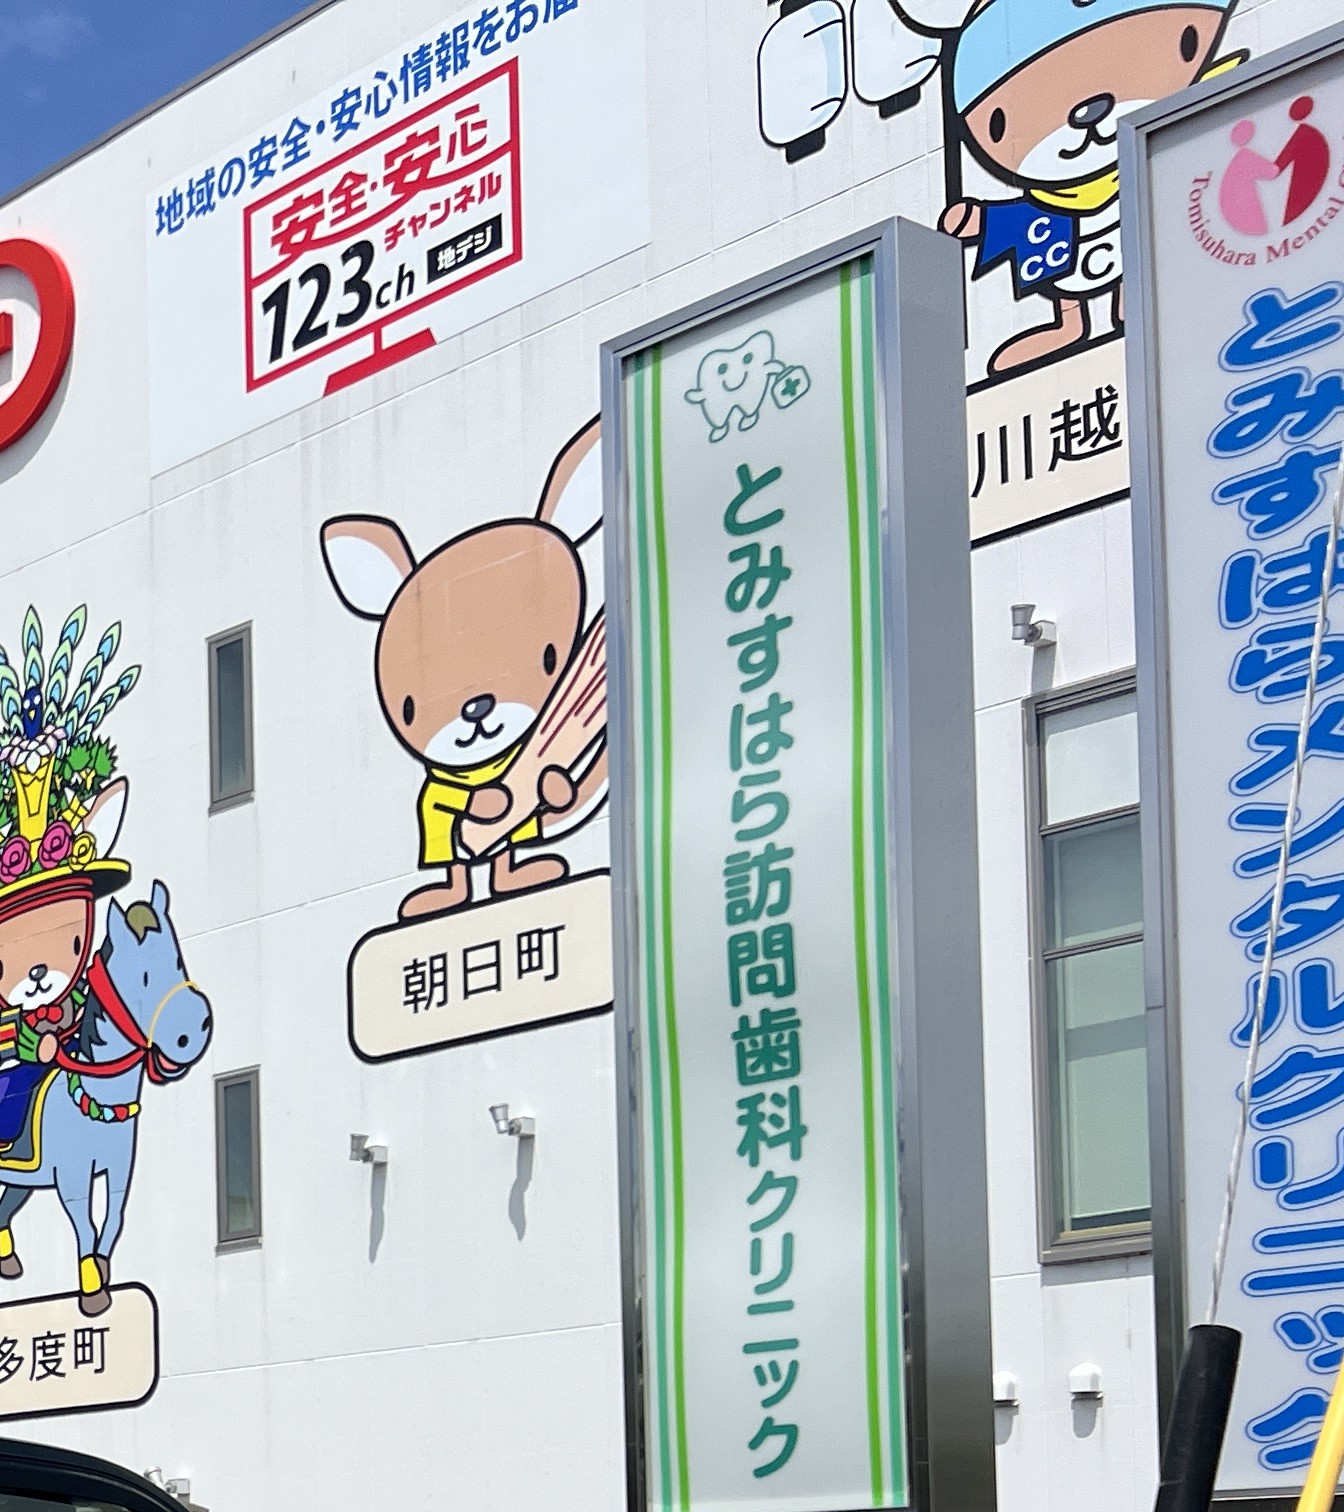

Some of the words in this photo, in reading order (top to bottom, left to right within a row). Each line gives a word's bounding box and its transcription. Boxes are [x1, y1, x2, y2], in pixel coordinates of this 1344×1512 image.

[270, 103, 488, 257] 安全・安心
[383, 171, 502, 252] チャンネル
[1187, 170, 1257, 267] Tomisuhara
[1266, 196, 1344, 263] Mental
[436, 223, 494, 272] 地デジ
[970, 384, 1123, 499] 川越
[402, 923, 567, 1015] 朝日町
[723, 462, 809, 1480] とみすはら訪問歯科クリニック
